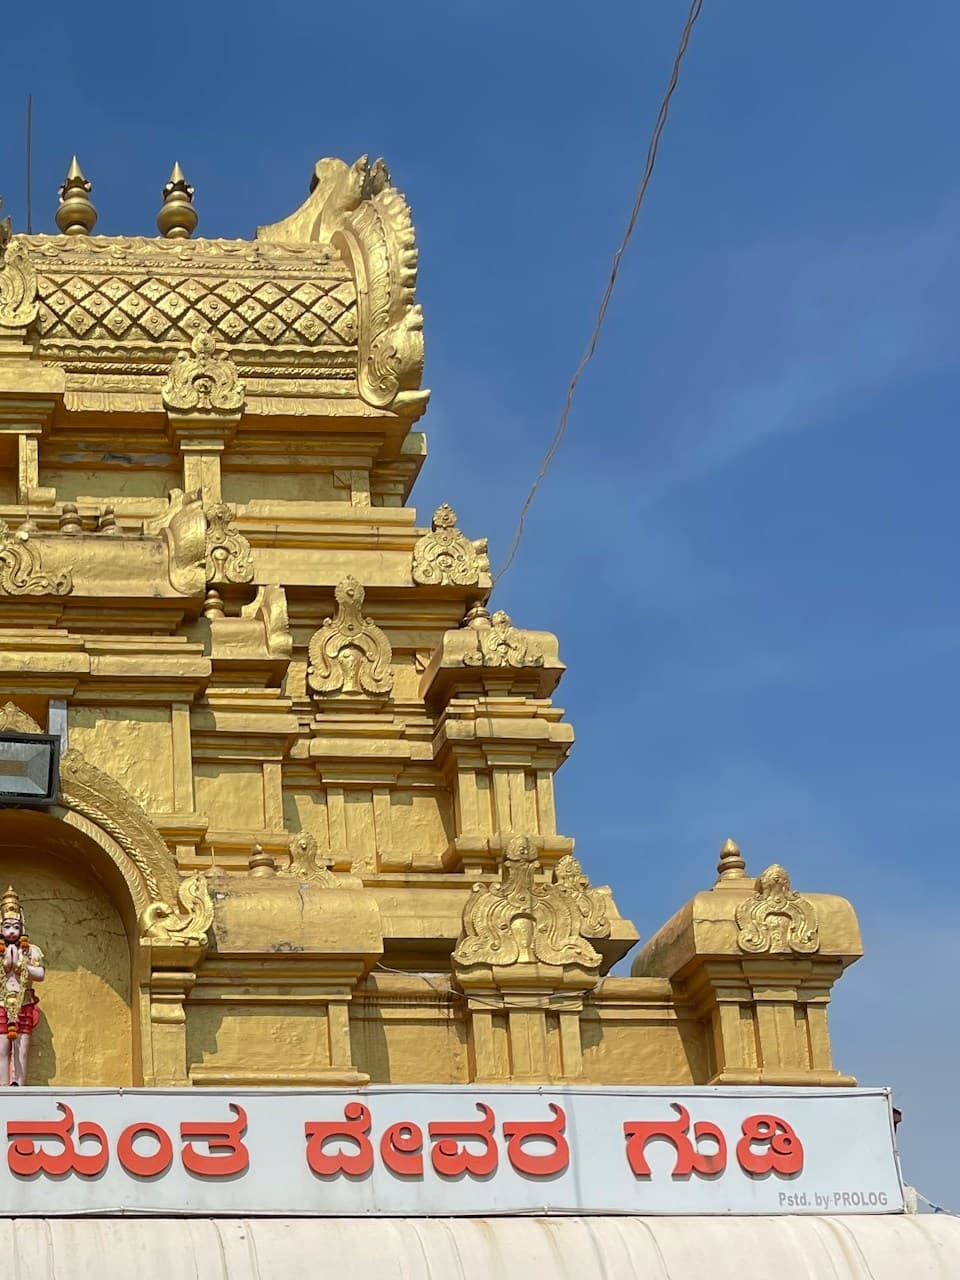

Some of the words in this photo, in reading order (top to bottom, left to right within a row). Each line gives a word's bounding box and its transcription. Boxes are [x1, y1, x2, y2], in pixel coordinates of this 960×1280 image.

[305, 1102, 571, 1178] ದೇವರ
[623, 1102, 805, 1177] ಗುಡಿ
[778, 1192, 811, 1206] Pstd.
